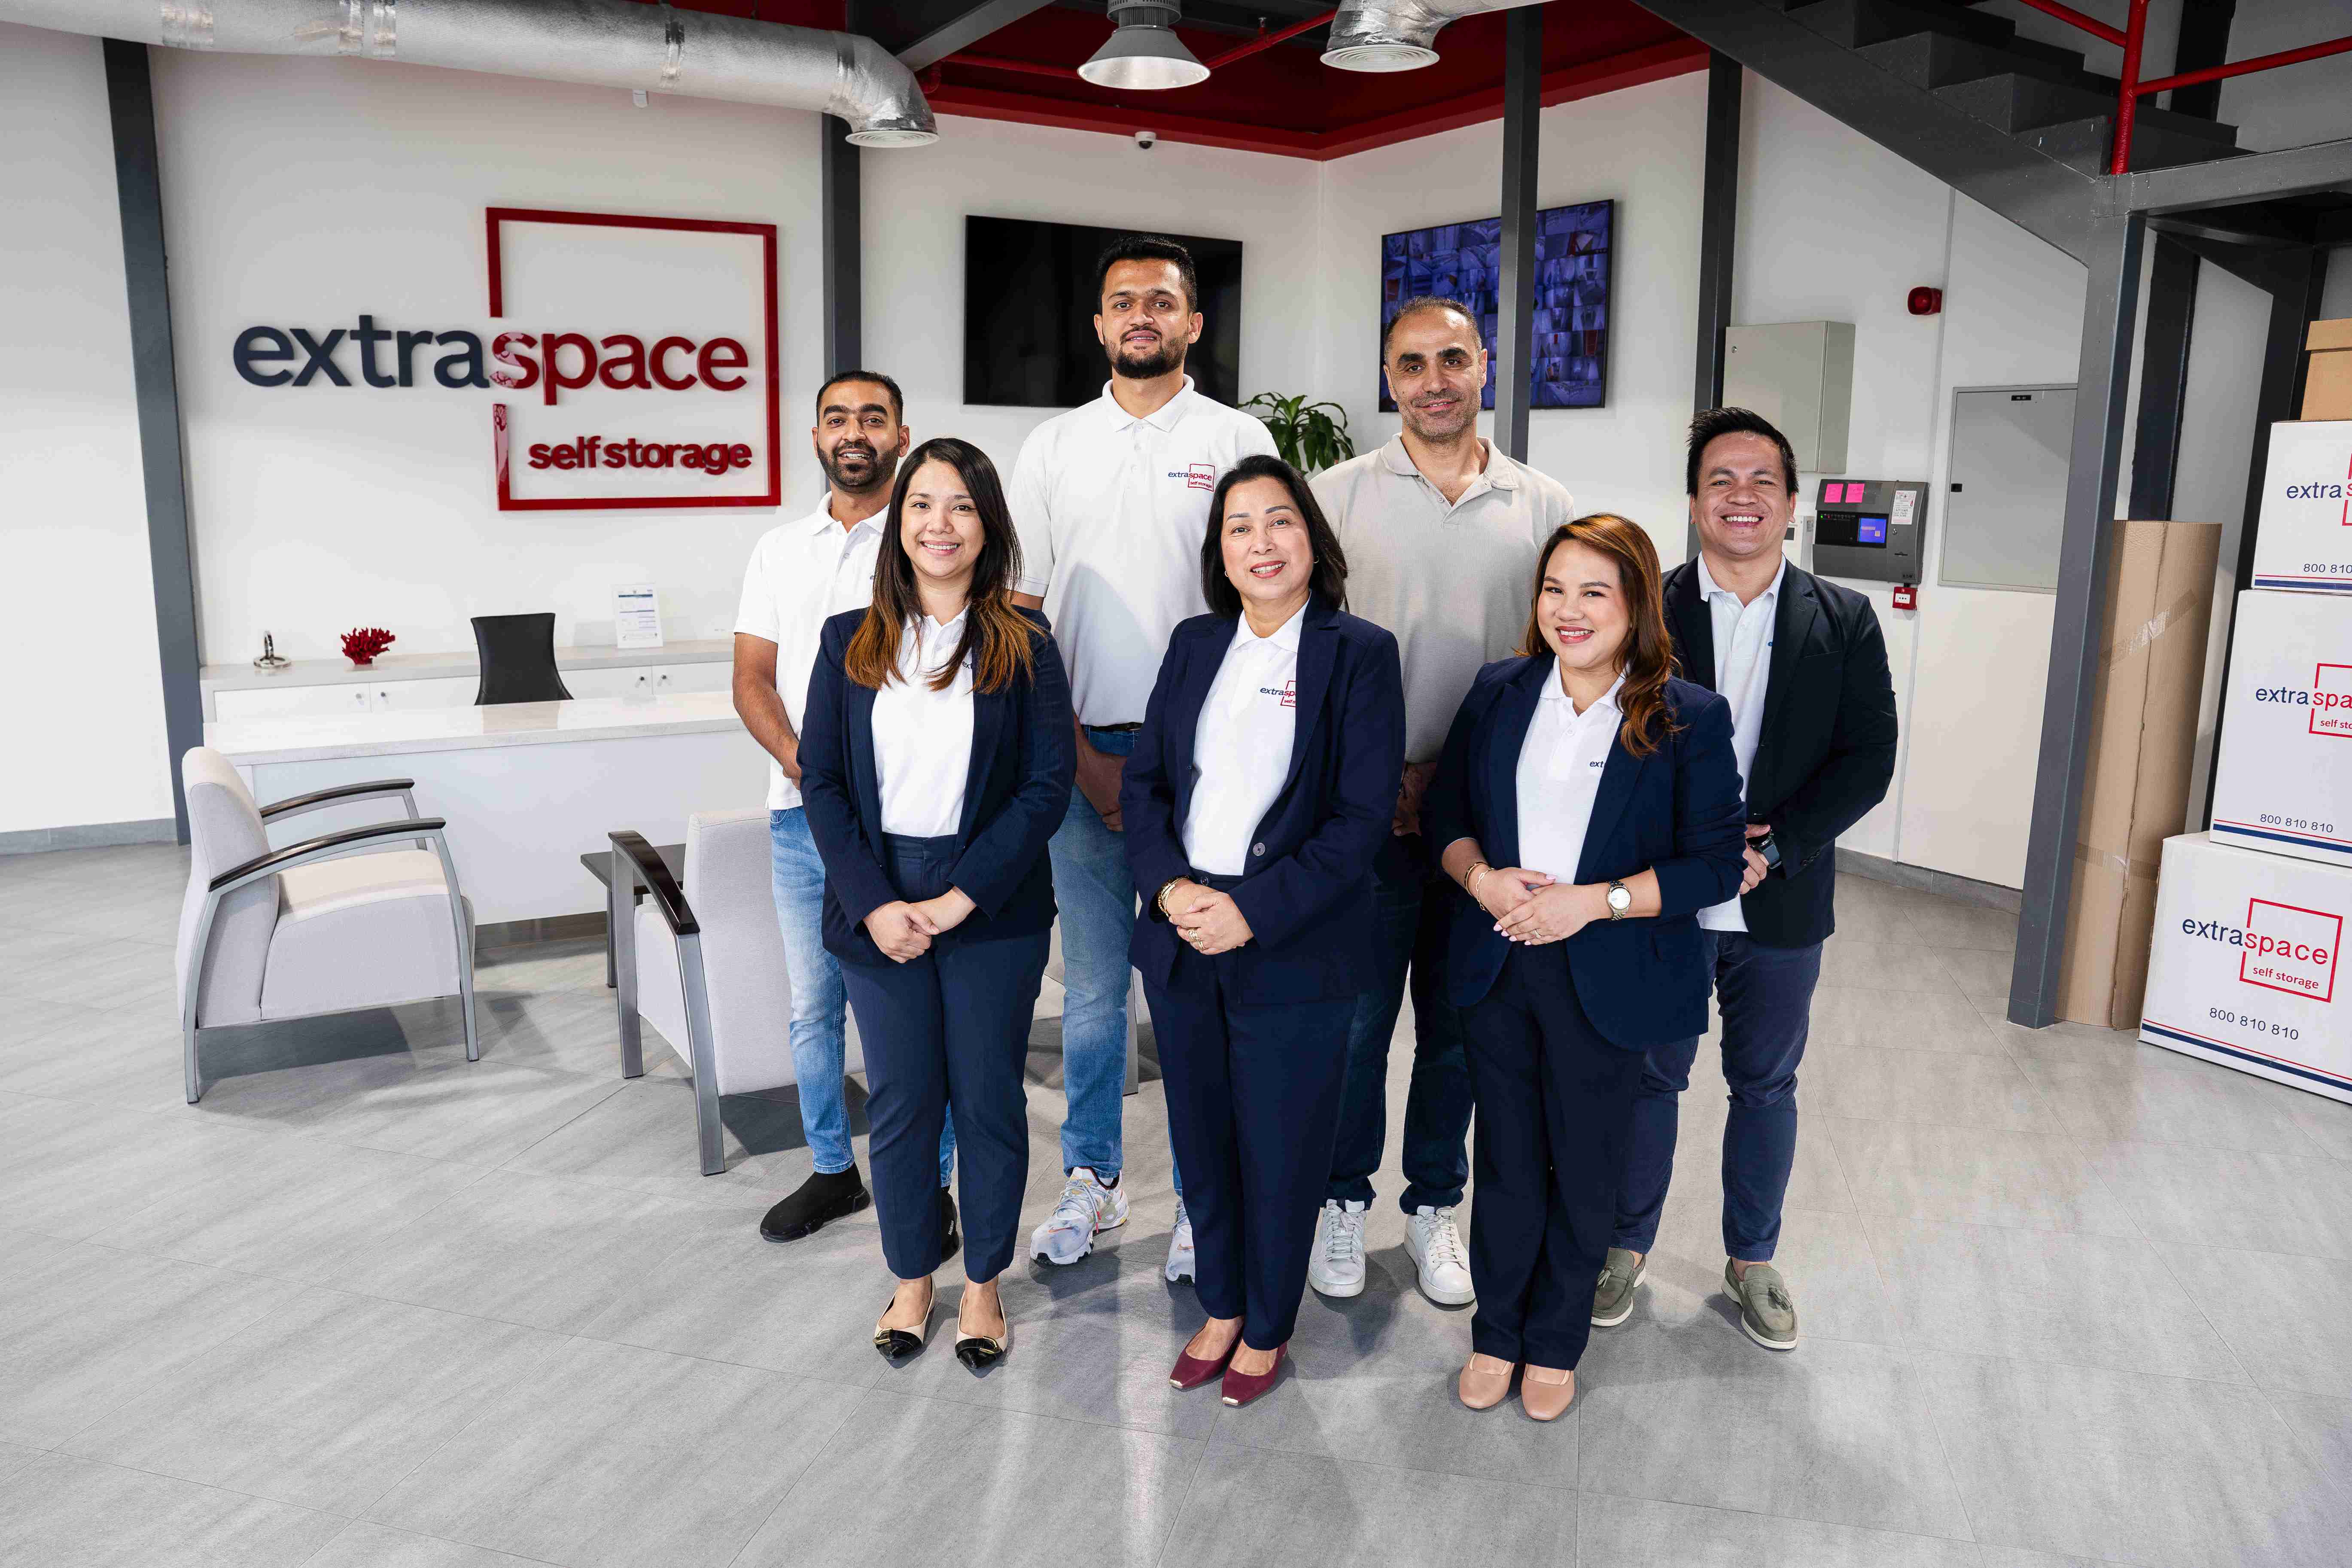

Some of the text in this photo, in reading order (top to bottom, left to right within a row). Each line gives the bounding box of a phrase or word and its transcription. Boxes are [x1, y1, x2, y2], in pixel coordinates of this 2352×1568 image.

[528, 436, 752, 475] self storage
[2303, 563, 2352, 573] 800 810
[2261, 814, 2333, 832] 800 810 810
[2253, 967, 2319, 989] self storage
[2210, 1008, 2298, 1040] 800 810 810
